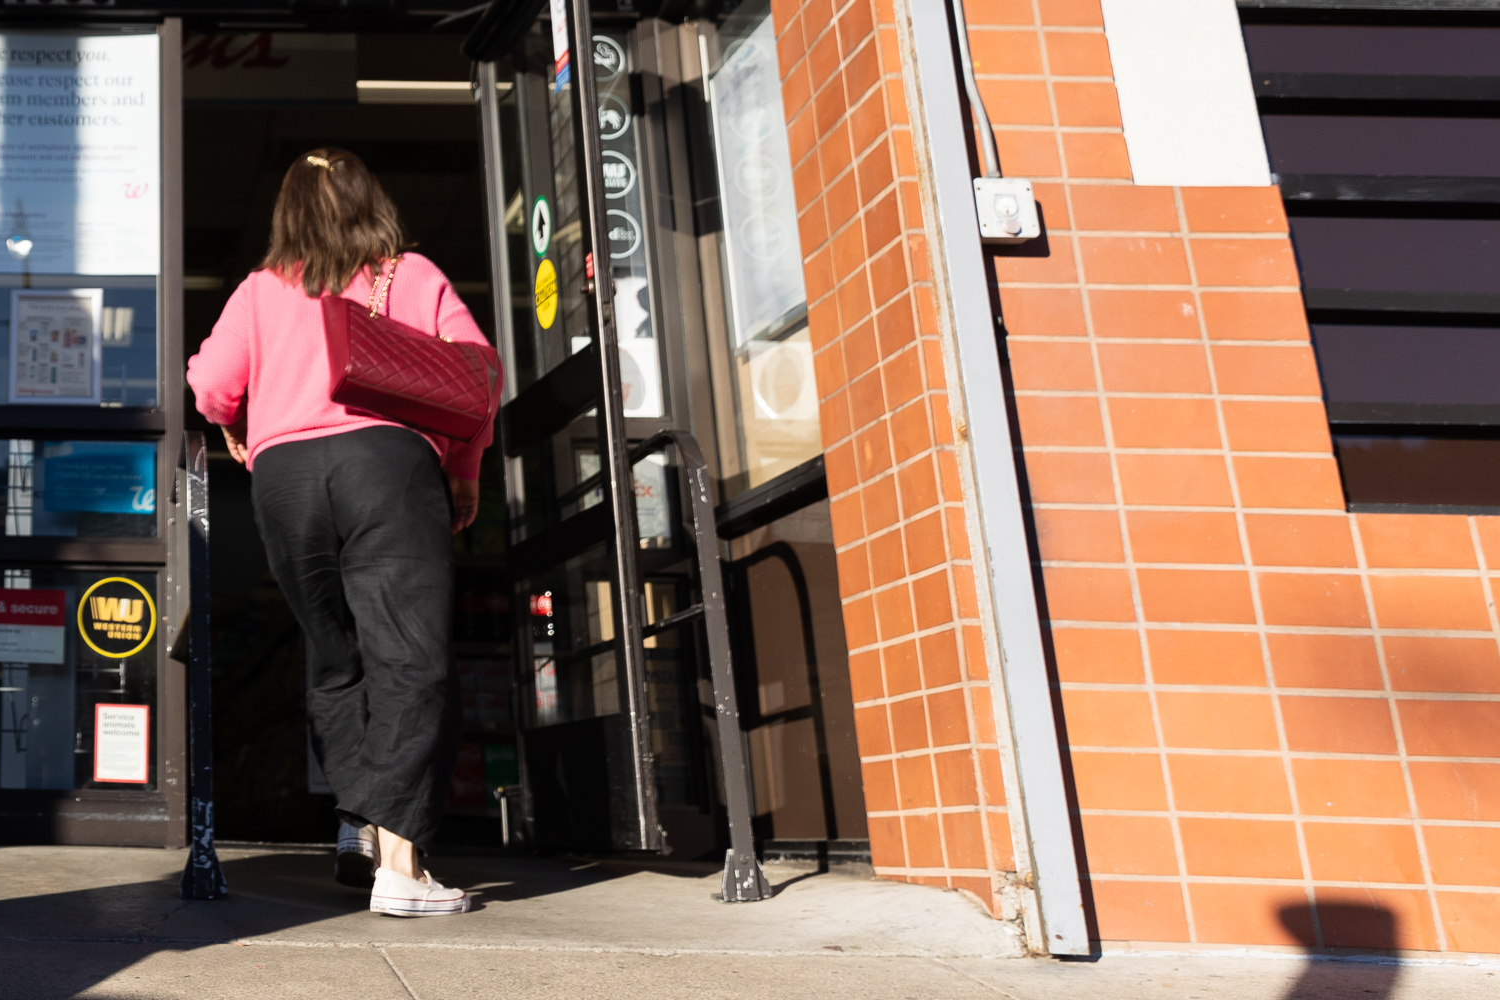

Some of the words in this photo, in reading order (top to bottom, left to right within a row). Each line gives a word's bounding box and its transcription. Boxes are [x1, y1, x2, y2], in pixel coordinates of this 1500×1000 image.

[10, 49, 72, 65] respect
[75, 49, 112, 65] you.
[38, 73, 99, 90] respect
[104, 75, 133, 87] our
[26, 92, 106, 107] members
[111, 92, 146, 106] and
[29, 114, 122, 127] customers.
[10, 603, 60, 616] secure
[90, 596, 143, 623] WU
[93, 622, 142, 632] WESTERN
[107, 631, 141, 641] UNION
[102, 713, 135, 721] Service
[102, 721, 135, 729] animals
[102, 729, 140, 737] welcome
